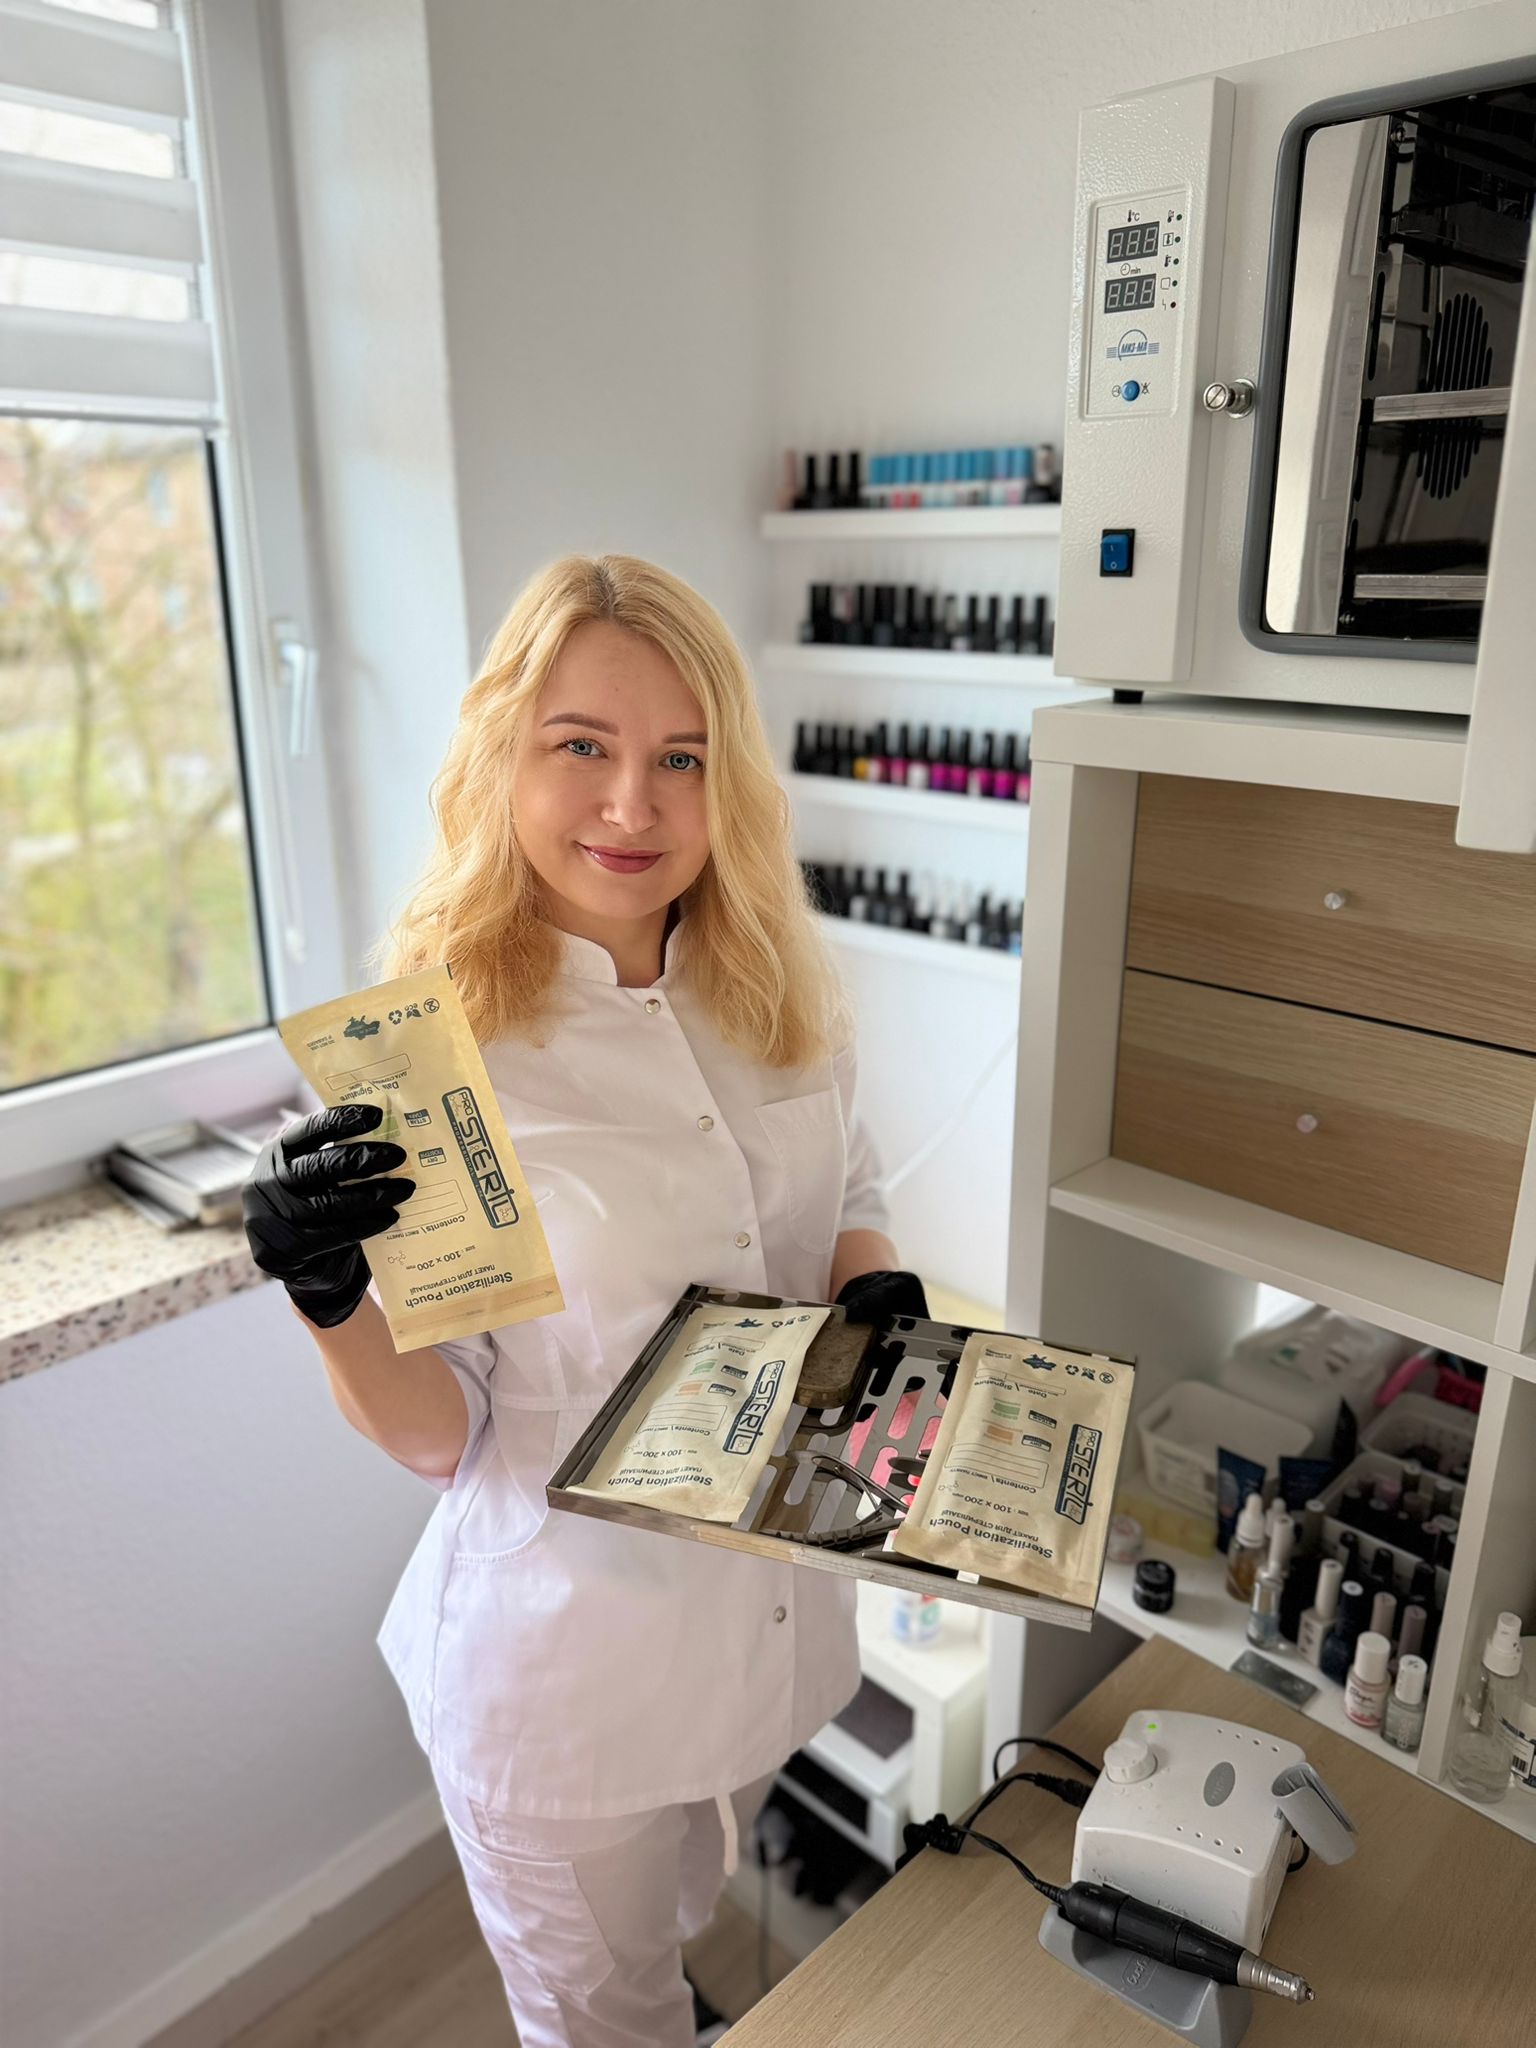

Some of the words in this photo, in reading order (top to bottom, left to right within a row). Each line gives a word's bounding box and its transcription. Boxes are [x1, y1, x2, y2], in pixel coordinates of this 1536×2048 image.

[404, 1003, 419, 1012] eco
[339, 1086, 373, 1102] Signature
[459, 1091, 474, 1116] PRO
[425, 1215, 466, 1233] Contents
[443, 1251, 461, 1262] 100
[417, 1260, 435, 1271] 200
[474, 1264, 495, 1275] ПАКЕТ
[456, 1270, 474, 1280] ДЛЯ
[445, 1271, 514, 1299] Sterilization
[405, 1291, 443, 1309] Pouch
[770, 1363, 781, 1379] PRO
[975, 1381, 1012, 1391] Signature
[1028, 1389, 1047, 1398] Date
[675, 1426, 710, 1436] Contents
[1087, 1431, 1097, 1447] PRO
[646, 1475, 713, 1487] Sterilization
[995, 1478, 1037, 1494] Contents
[964, 1495, 984, 1505] 200
[993, 1503, 1012, 1513] 100
[929, 1518, 971, 1534] Pouch
[995, 1524, 1012, 1533] ДЛЯ
[1013, 1530, 1038, 1541] ПАКЕТ
[973, 1529, 1053, 1559] Sterilization
